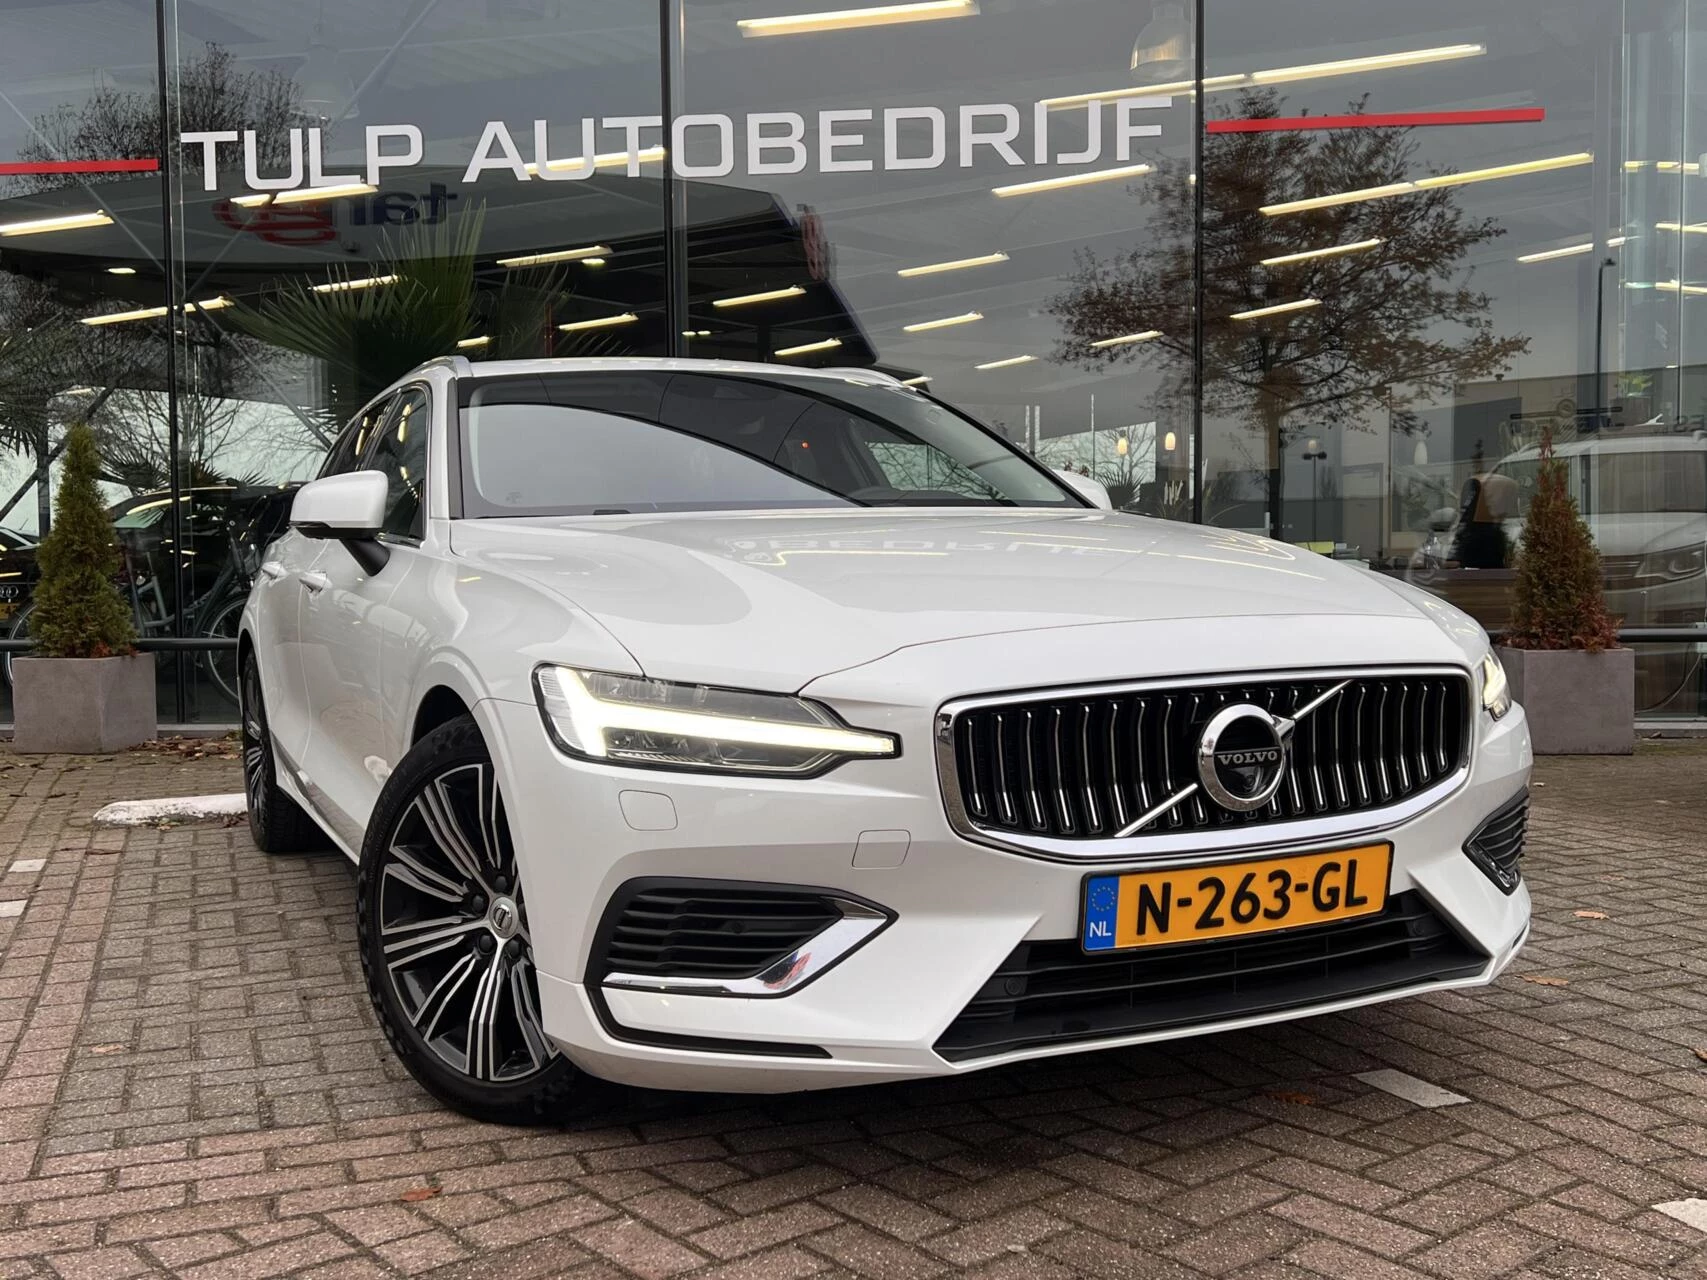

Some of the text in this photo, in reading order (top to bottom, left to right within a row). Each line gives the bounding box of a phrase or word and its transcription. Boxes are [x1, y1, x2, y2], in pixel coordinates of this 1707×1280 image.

[180, 96, 1173, 192] TULP AUTOBEDRIJF
[1217, 750, 1278, 766] VOLVO
[1136, 858, 1369, 936] N-263-GL
[1089, 920, 1112, 938] NL
